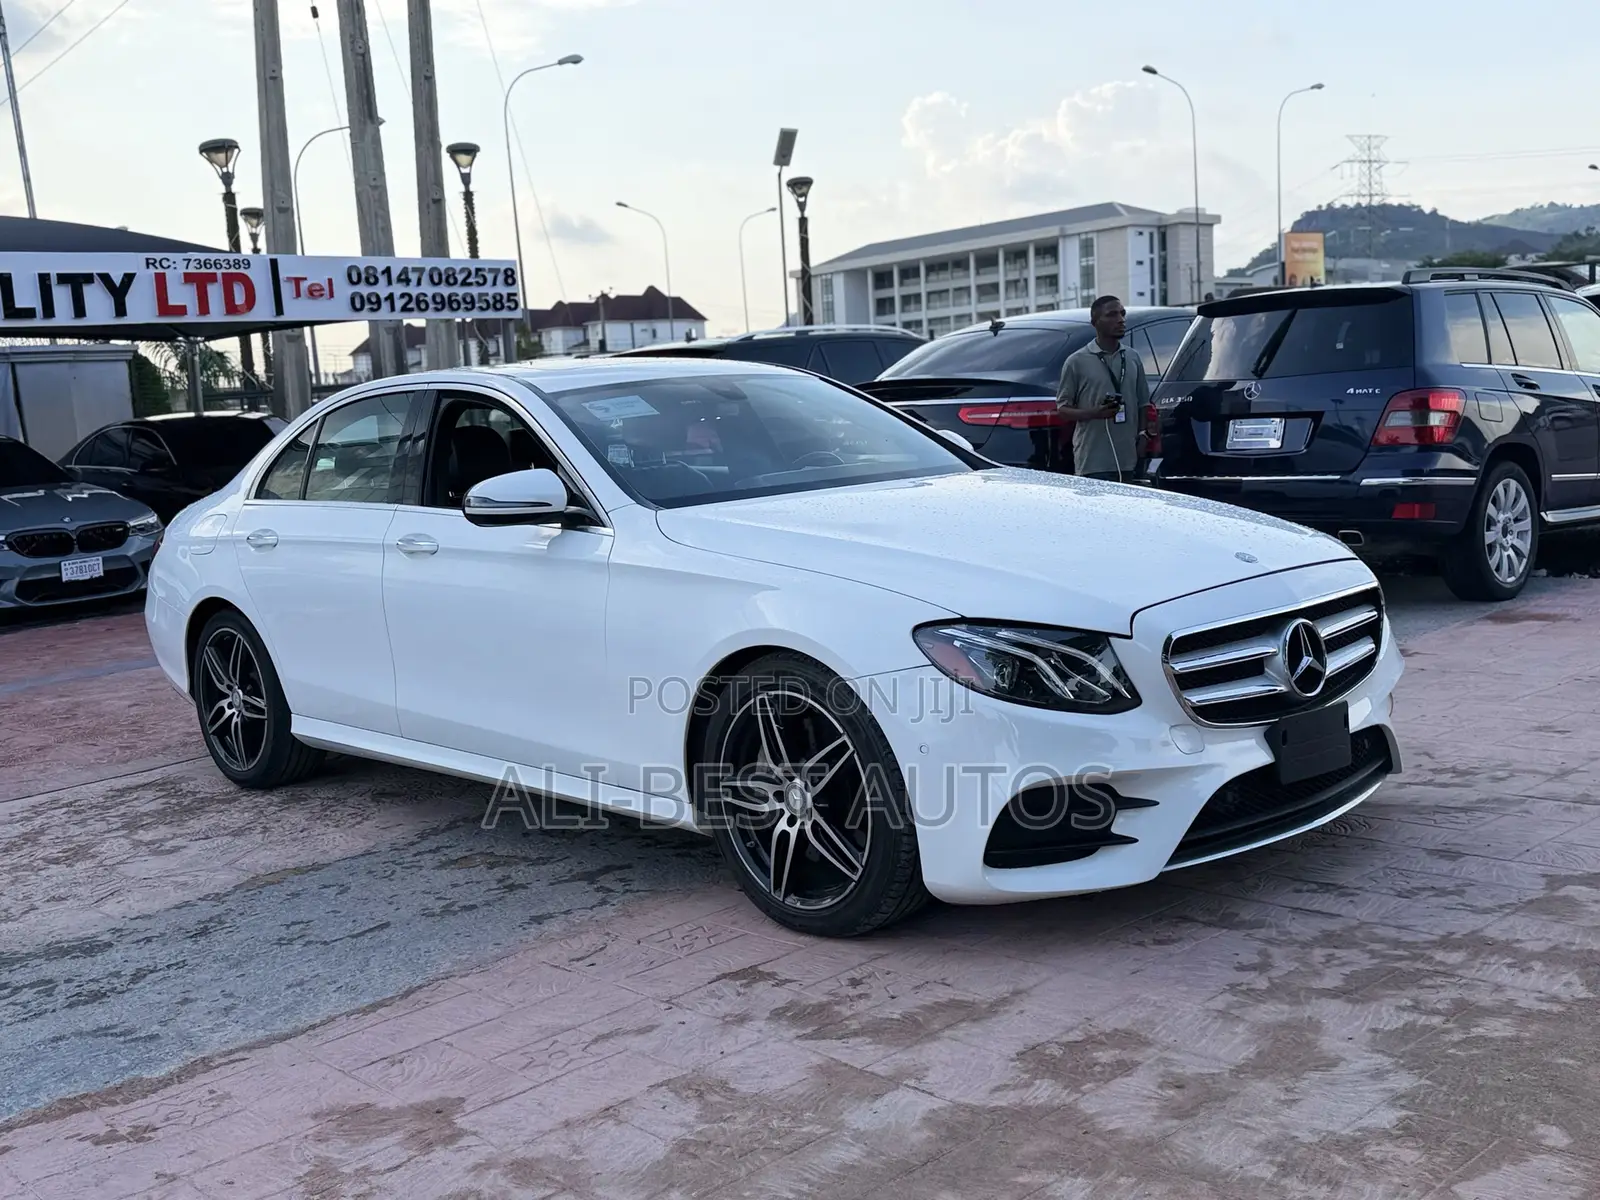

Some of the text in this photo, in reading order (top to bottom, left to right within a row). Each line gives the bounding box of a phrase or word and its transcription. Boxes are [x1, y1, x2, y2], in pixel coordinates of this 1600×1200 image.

[145, 257, 251, 270] RC: 7366389
[346, 265, 517, 287] 08147082578
[153, 272, 257, 317] LTD
[285, 276, 335, 300] Tel
[350, 291, 519, 313] 09126969585
[1345, 387, 1381, 395] 4MATC
